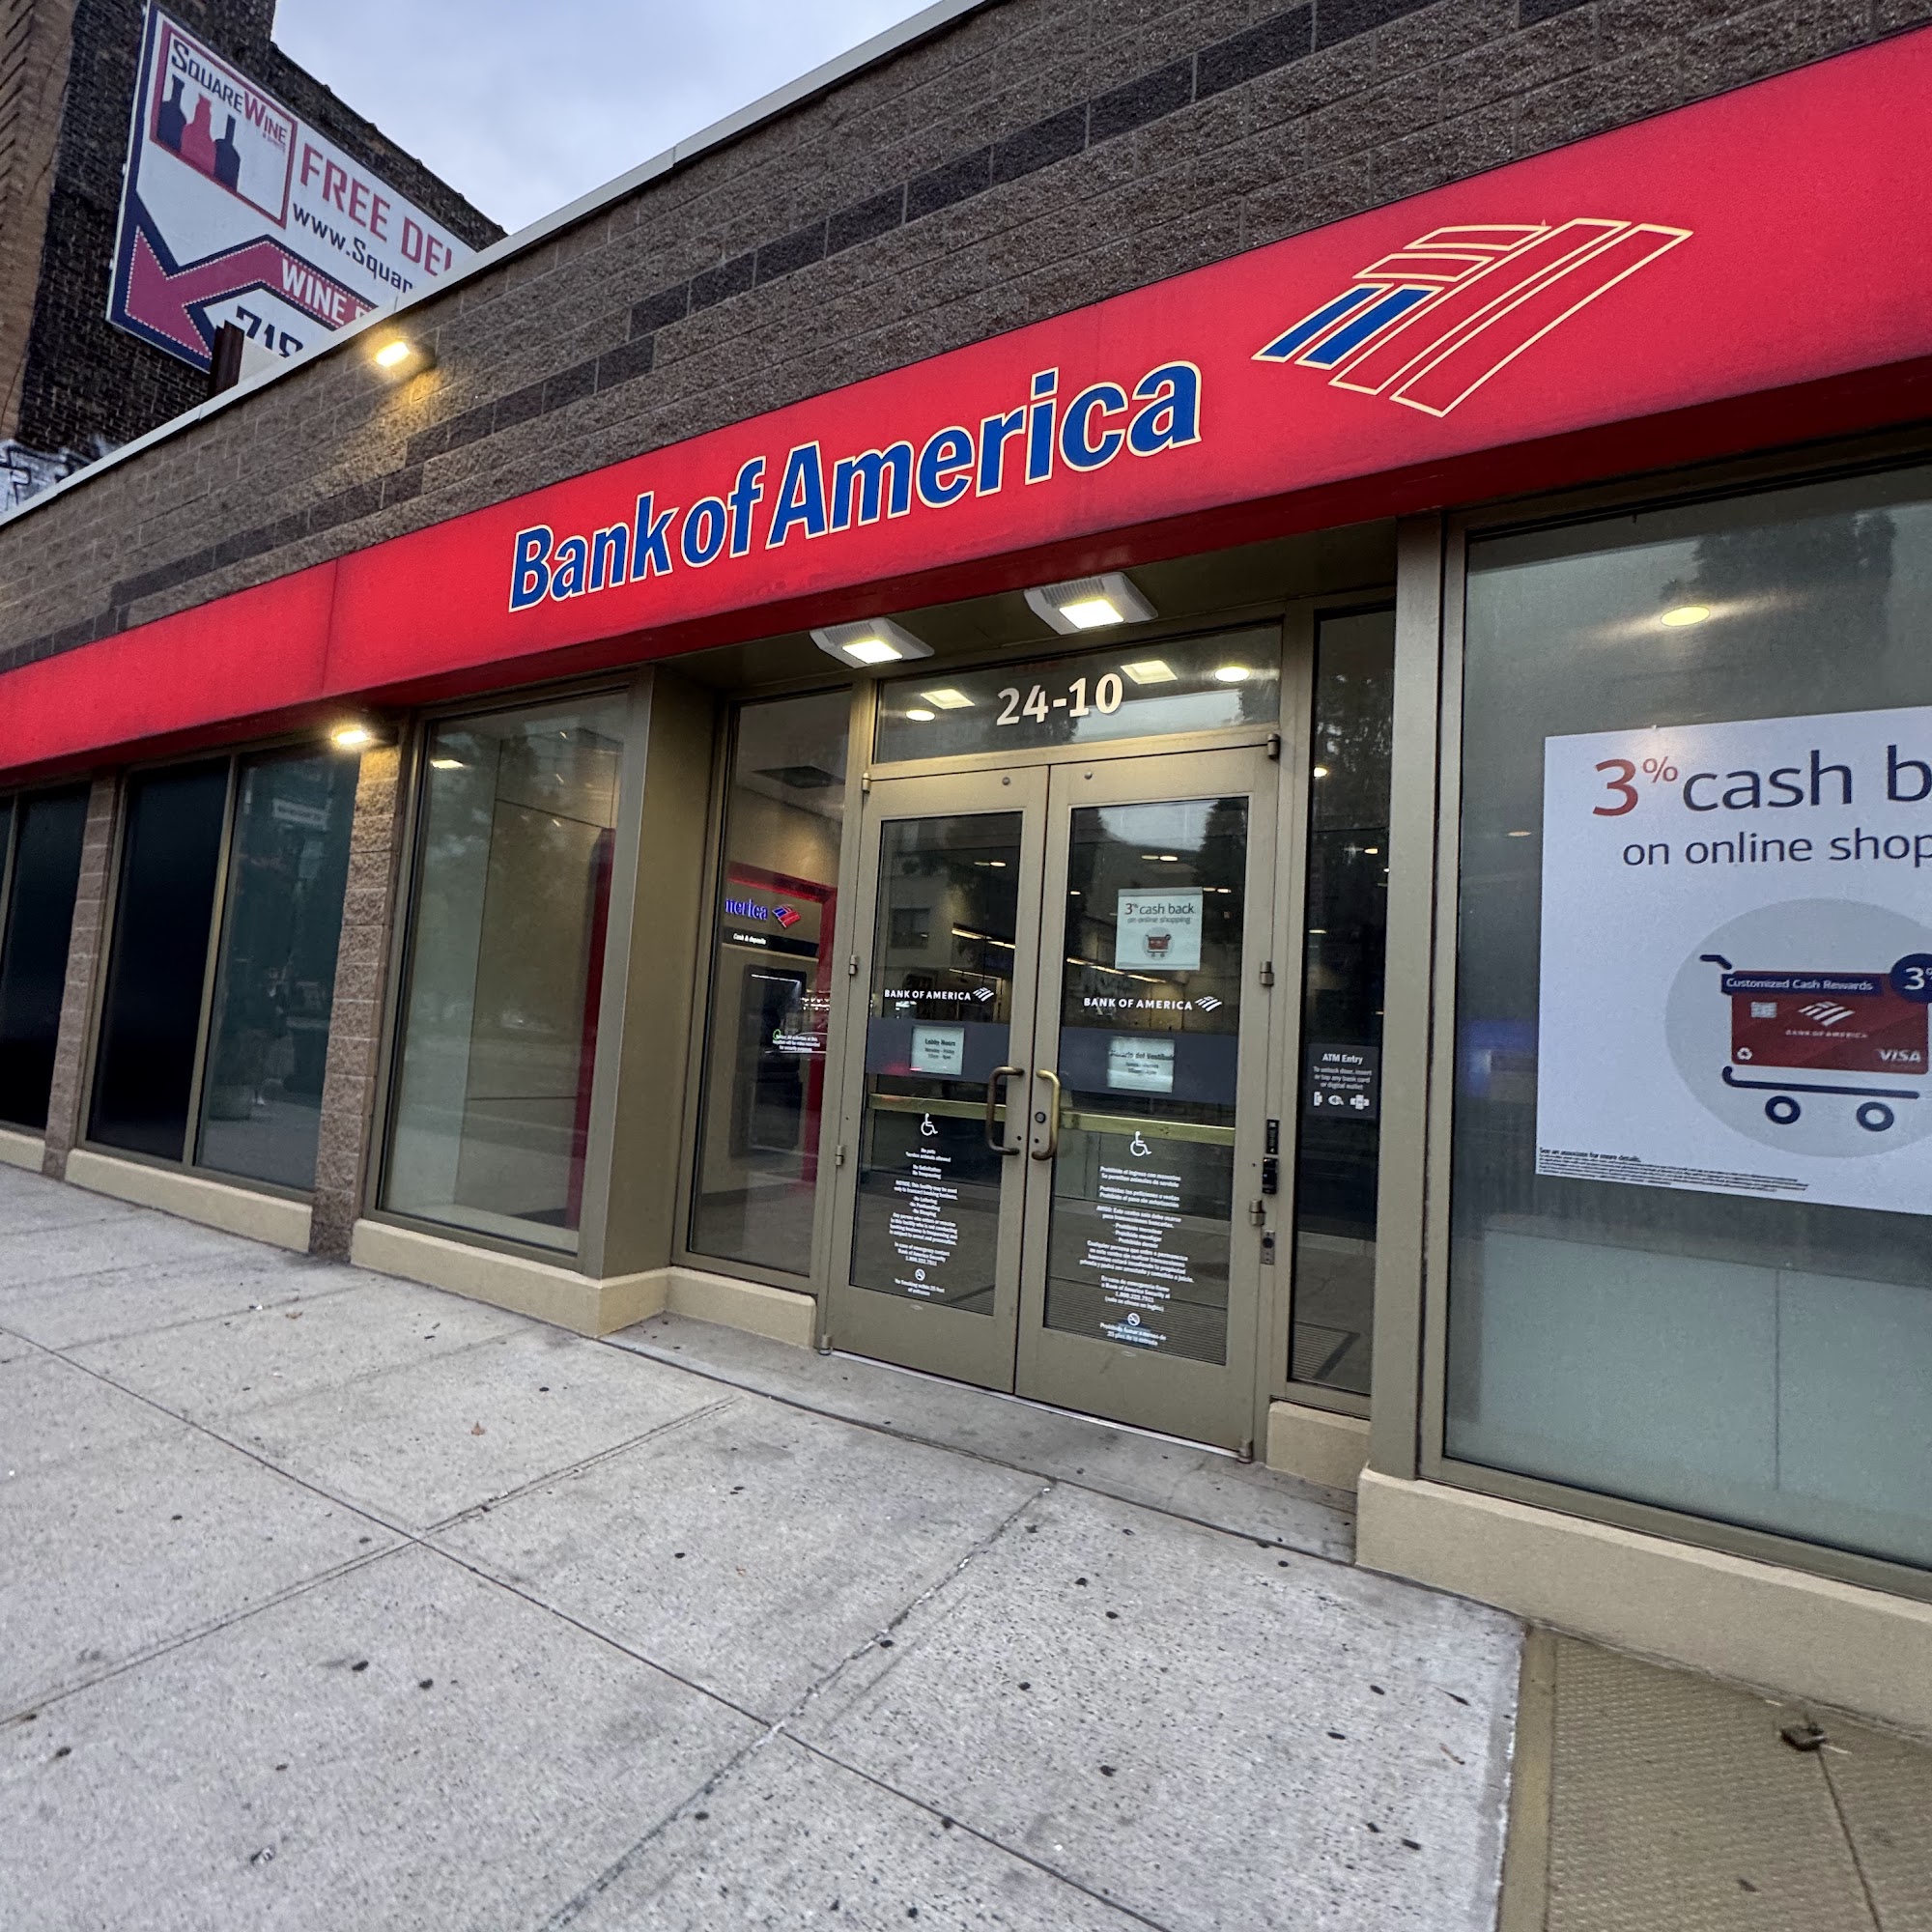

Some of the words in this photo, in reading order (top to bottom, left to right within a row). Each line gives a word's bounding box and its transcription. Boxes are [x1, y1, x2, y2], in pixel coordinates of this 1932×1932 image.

[300, 143, 390, 243] FREE
[282, 258, 347, 326] WINE
[508, 490, 679, 612] Bank
[680, 455, 766, 569] of
[766, 359, 1204, 551] America
[996, 673, 1123, 725] 24-10
[1592, 755, 1678, 817] 3%
[1683, 750, 1852, 812] cash
[1623, 840, 1668, 867] on
[1685, 832, 1812, 865] online
[1829, 827, 1932, 868] shop
[1140, 903, 1164, 914] cash
[1169, 902, 1194, 914] back
[884, 989, 910, 999] BANK
[912, 990, 925, 999] OF
[926, 991, 971, 1001] AMERICA
[1725, 979, 1790, 989] Customized
[1792, 979, 1820, 989] Cash
[1823, 980, 1873, 991] Rewards
[1084, 997, 1116, 1008] BANK
[1119, 999, 1135, 1009] OF
[1136, 999, 1193, 1010] AMERICA
[1322, 1053, 1341, 1062] ATM
[1342, 1054, 1363, 1065] Entry
[1878, 1048, 1921, 1063] VISA
